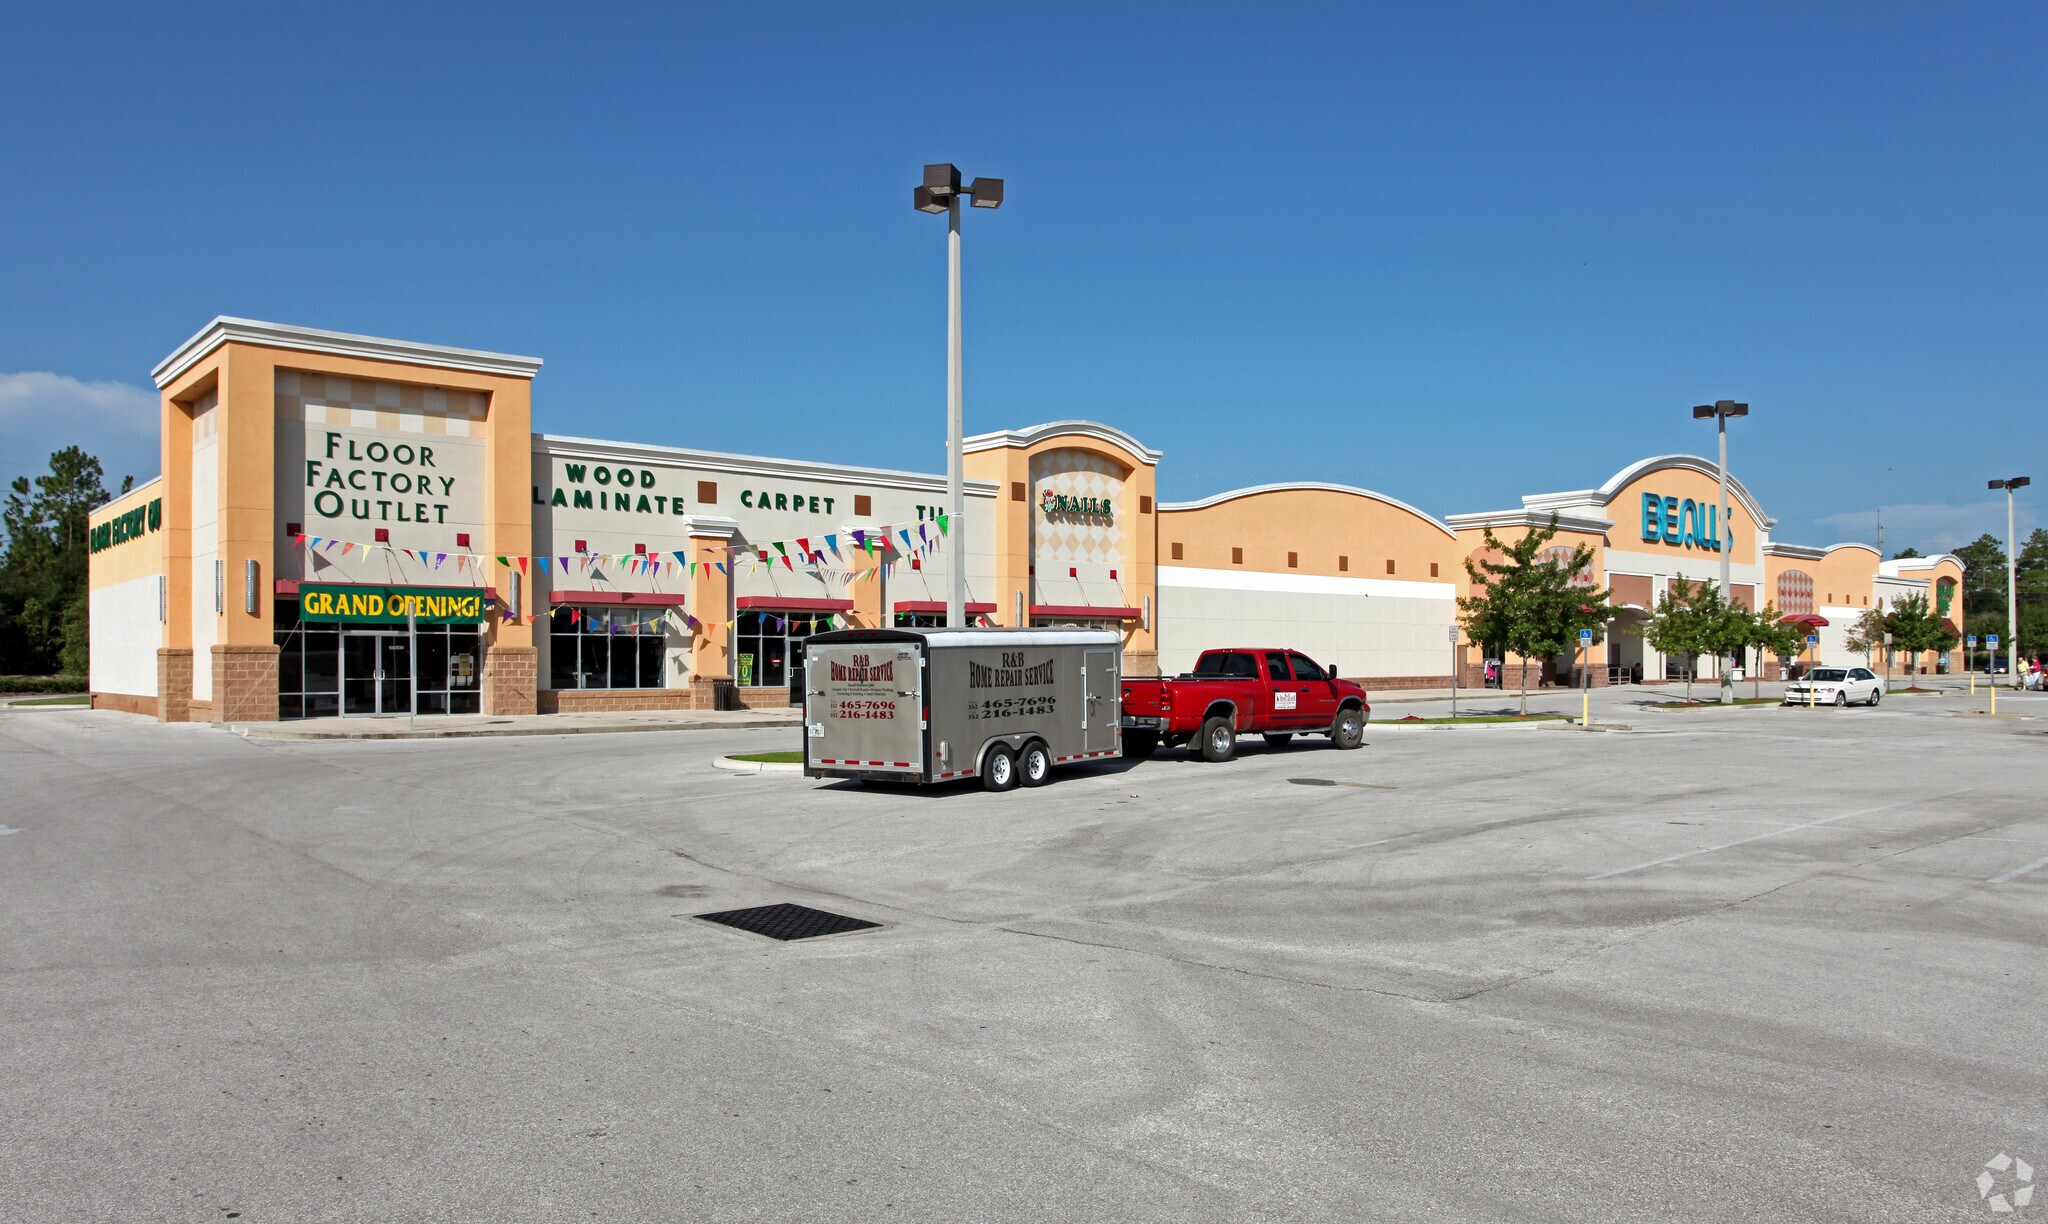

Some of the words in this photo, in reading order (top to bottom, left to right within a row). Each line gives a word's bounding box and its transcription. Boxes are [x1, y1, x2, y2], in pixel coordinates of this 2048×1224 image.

[326, 432, 436, 467] FLOOR
[306, 460, 455, 496] FACTORY
[565, 463, 656, 488] WOOD
[314, 490, 449, 524] OUTLET
[533, 485, 684, 515] LAMINATE
[740, 489, 835, 515] CARPET
[1056, 494, 1111, 515] NAILS
[304, 592, 384, 617] GRAND
[387, 594, 480, 618] OPENING!
[830, 660, 847, 682] HOME
[848, 667, 869, 682] REPAIR
[870, 660, 894, 682] SERVICE
[853, 654, 870, 667] R&B
[1002, 652, 1025, 668] R&B
[969, 660, 992, 688] HOME
[994, 669, 1023, 688] REPAIR
[1024, 658, 1054, 686] SERVICE
[839, 700, 896, 710] 465-7696
[981, 696, 1056, 709] 465-7696
[981, 705, 1055, 719] 216-1483
[839, 710, 894, 719] 216-1483
